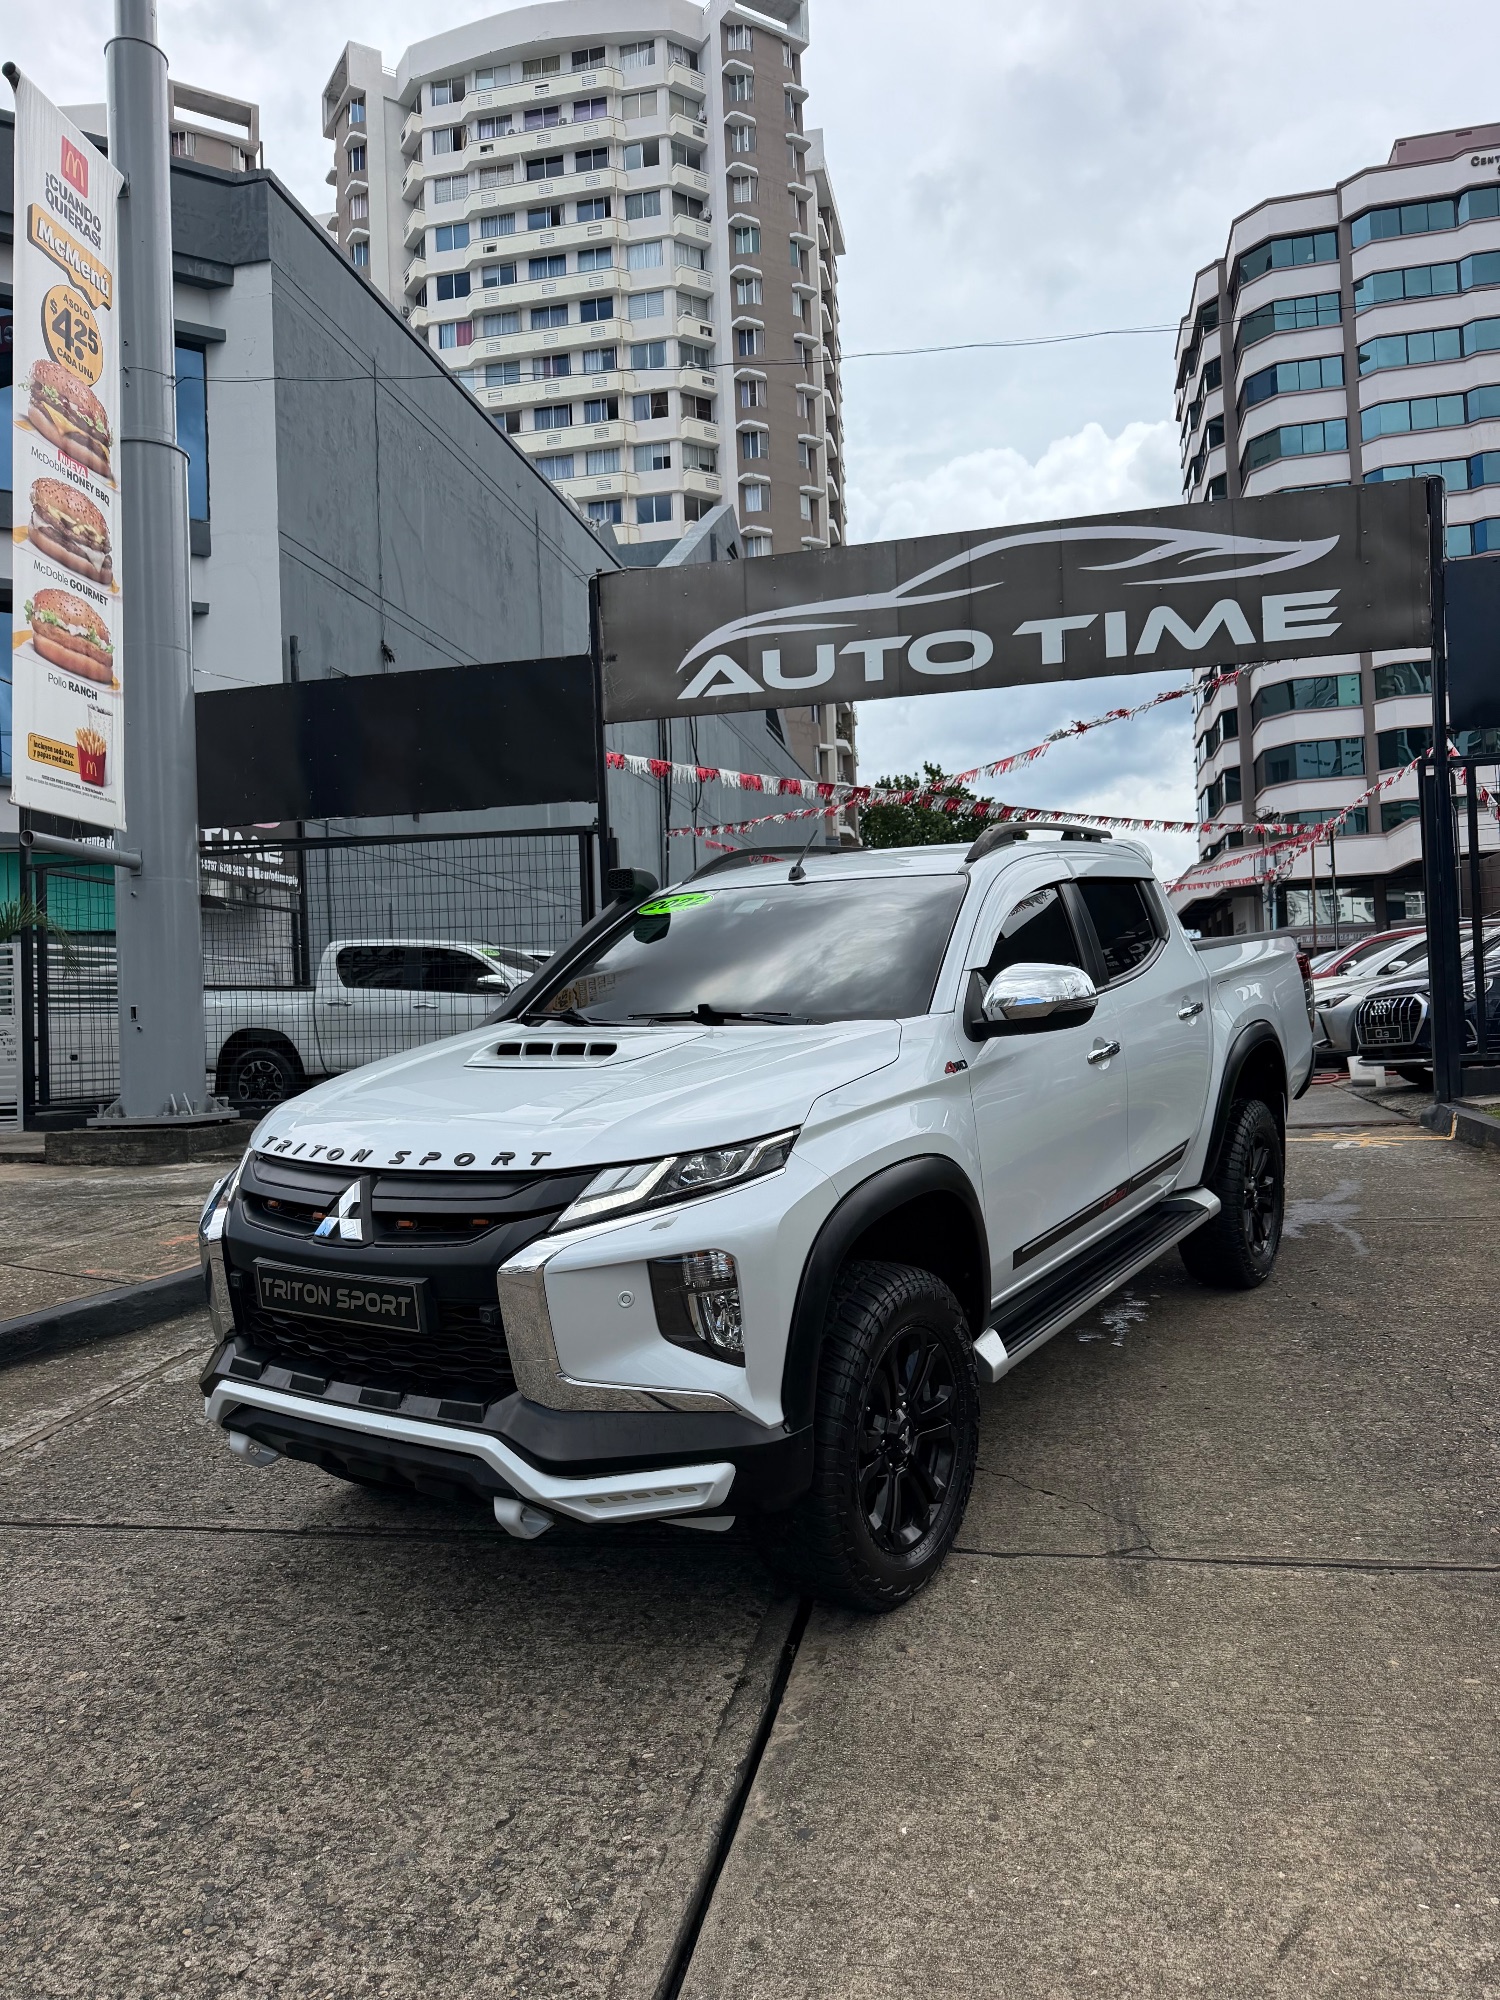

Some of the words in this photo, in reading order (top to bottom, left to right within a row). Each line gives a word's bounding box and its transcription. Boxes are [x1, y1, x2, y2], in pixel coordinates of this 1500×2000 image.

[45, 190, 102, 250] QUIERAS!
[46, 171, 102, 233] ¡CUANDO
[37, 217, 110, 299] McMenú
[57, 346, 78, 369] CADA
[78, 364, 94, 381] UNA
[31, 446, 66, 476] McDoble
[66, 468, 94, 493] HONEY
[95, 487, 110, 507] BBQ
[59, 454, 87, 478] NUEVA
[33, 560, 69, 586] McDoble
[69, 578, 108, 606] GOURMET
[677, 629, 996, 701] AUTO
[1012, 588, 1342, 666] TIME
[47, 672, 67, 689] Pollo
[68, 681, 98, 701] RANCH
[261, 1135, 374, 1163] TRITON
[387, 1150, 552, 1167] SPORT
[262, 1277, 332, 1306] TRITON
[336, 1288, 412, 1317] SPORT
